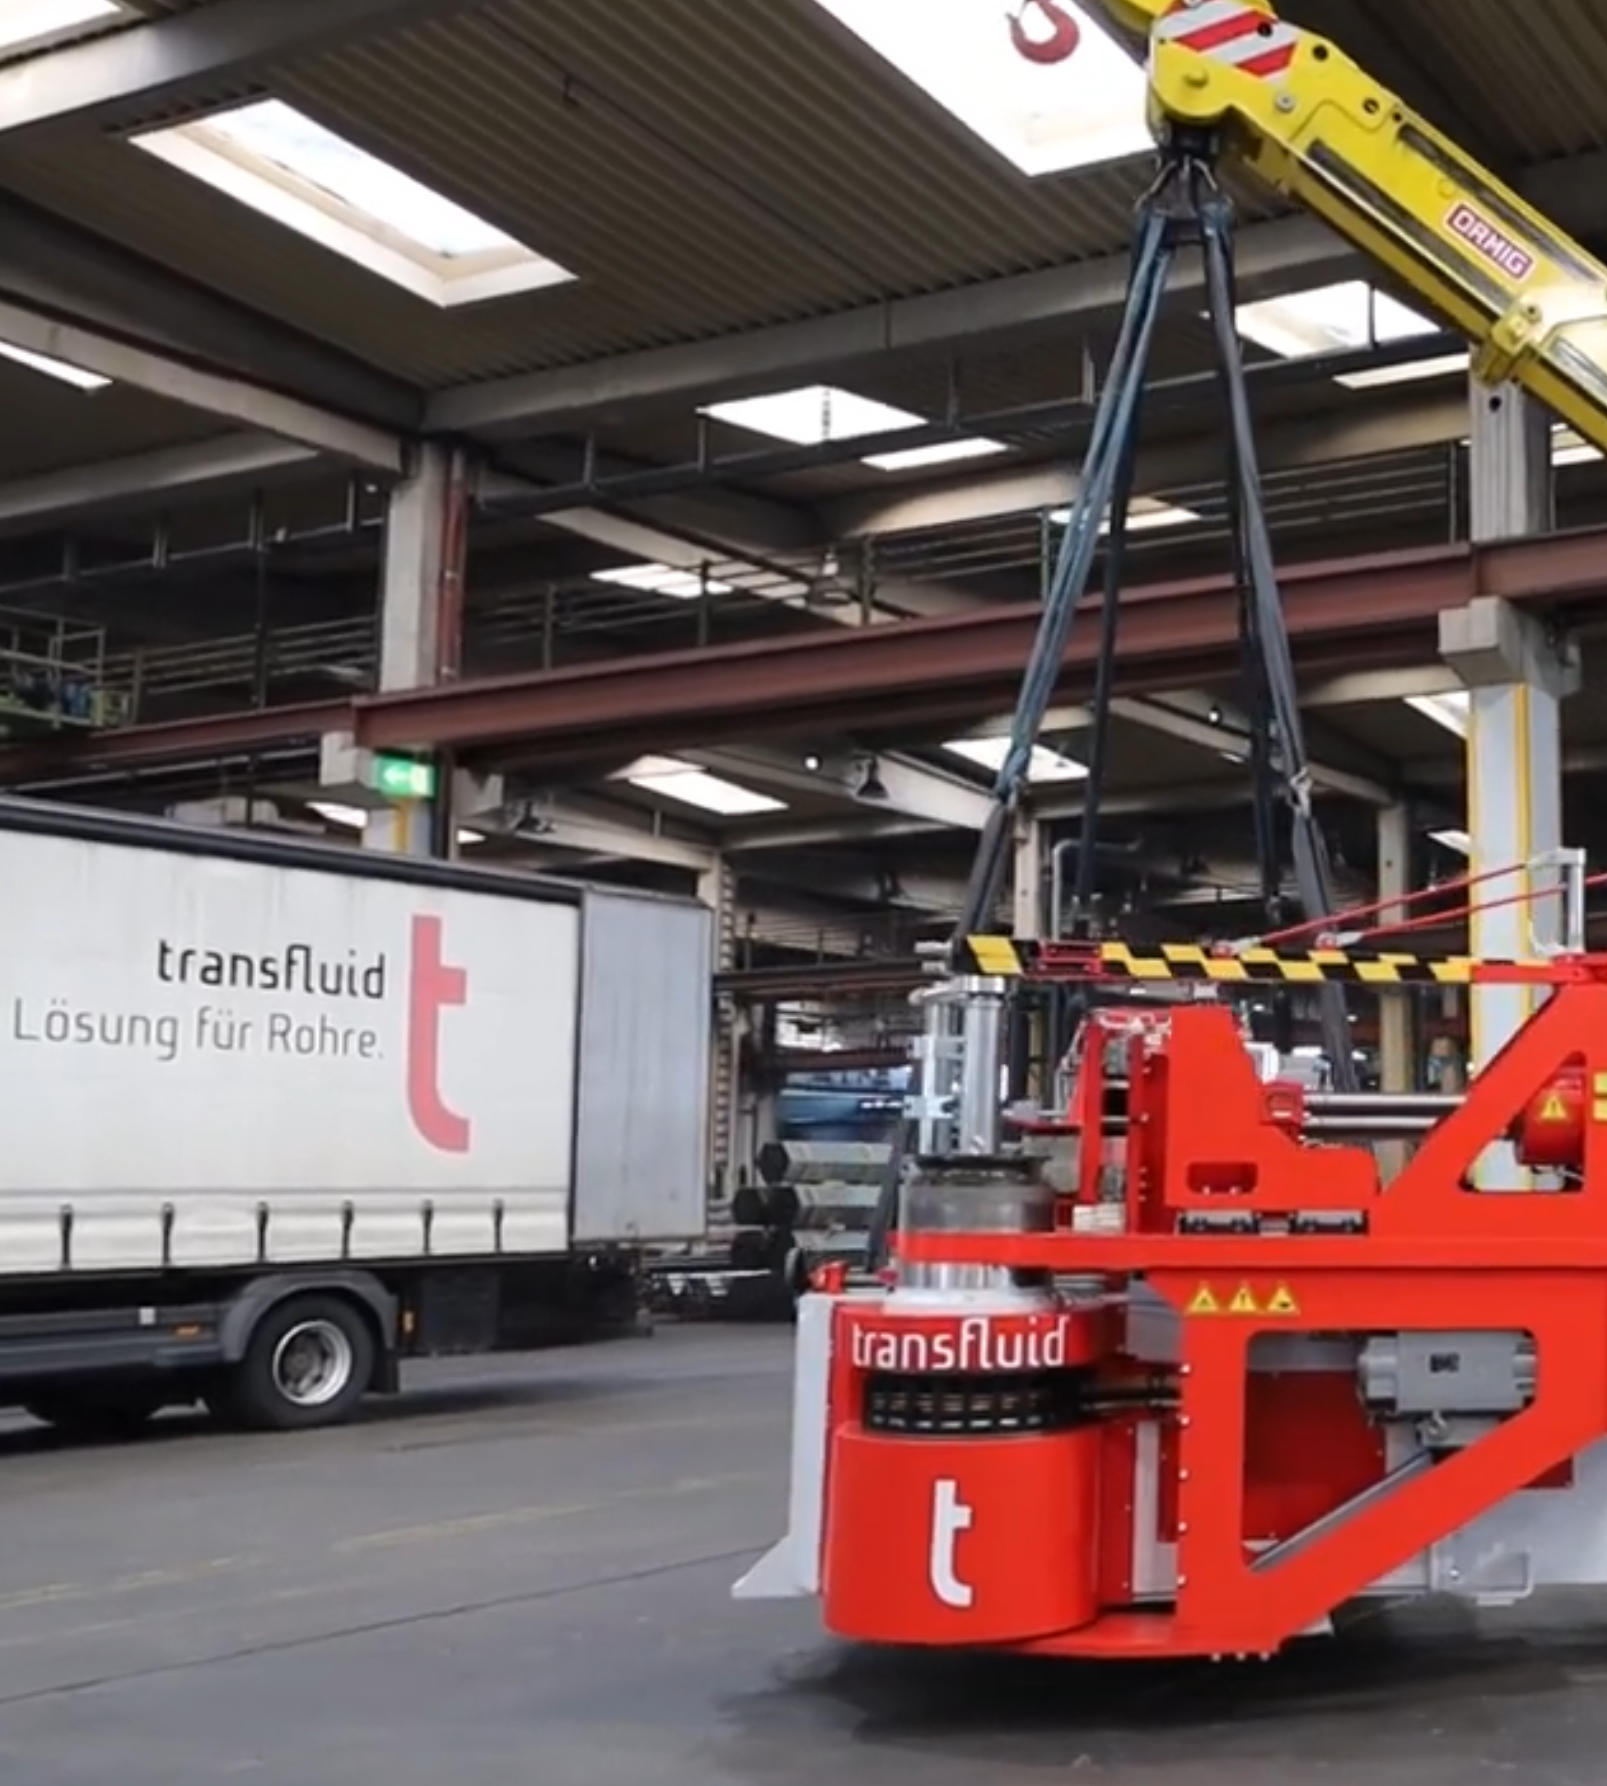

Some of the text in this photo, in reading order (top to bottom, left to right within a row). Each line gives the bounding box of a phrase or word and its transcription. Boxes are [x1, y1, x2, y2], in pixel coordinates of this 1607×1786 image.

[1453, 207, 1530, 277] ORMIG
[156, 939, 386, 999] transfluid
[13, 997, 384, 1061] Lösung für Rohre.
[407, 914, 470, 1152] t
[852, 1315, 1070, 1369] transfluid
[930, 1479, 972, 1607] t
